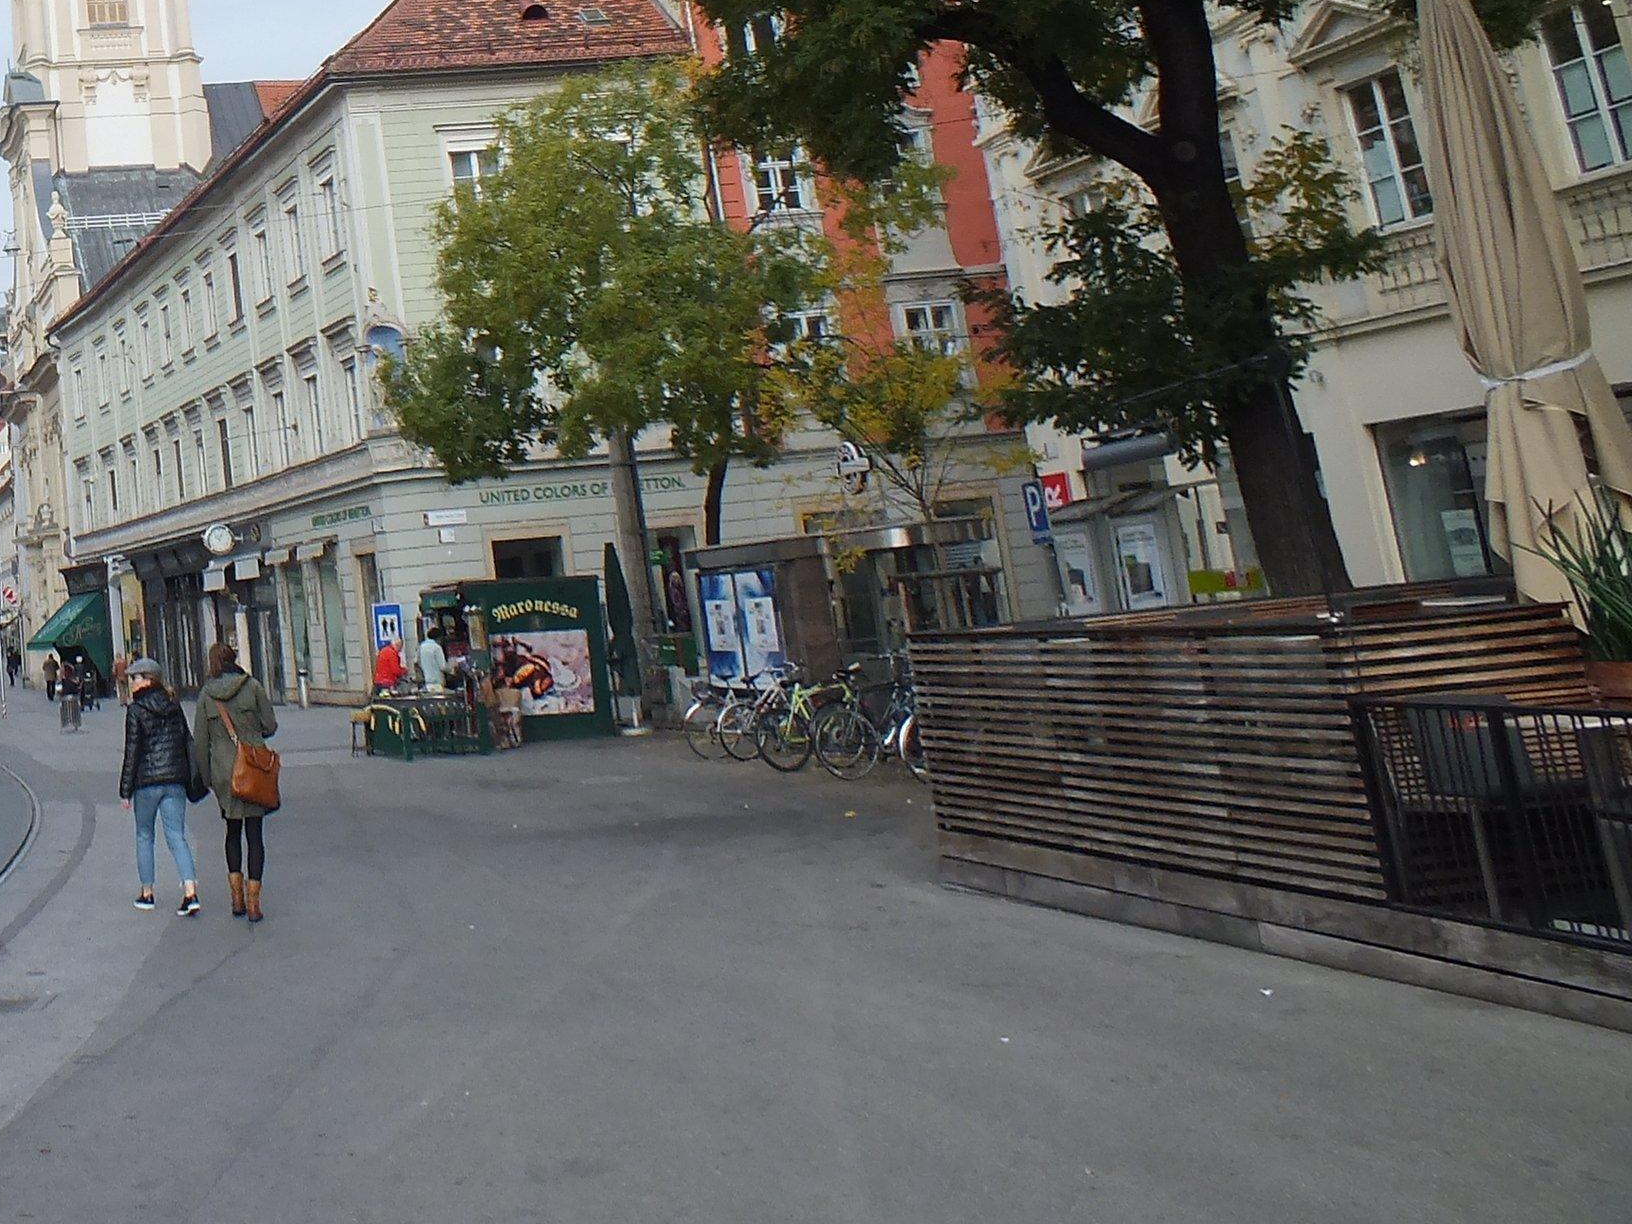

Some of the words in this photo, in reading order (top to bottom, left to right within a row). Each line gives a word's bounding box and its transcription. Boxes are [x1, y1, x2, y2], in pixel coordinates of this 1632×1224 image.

[479, 489, 530, 505] UNITED
[533, 485, 587, 500] COLORS
[592, 482, 609, 495] OF
[1026, 485, 1041, 527] P
[491, 599, 581, 623] Maronessa
